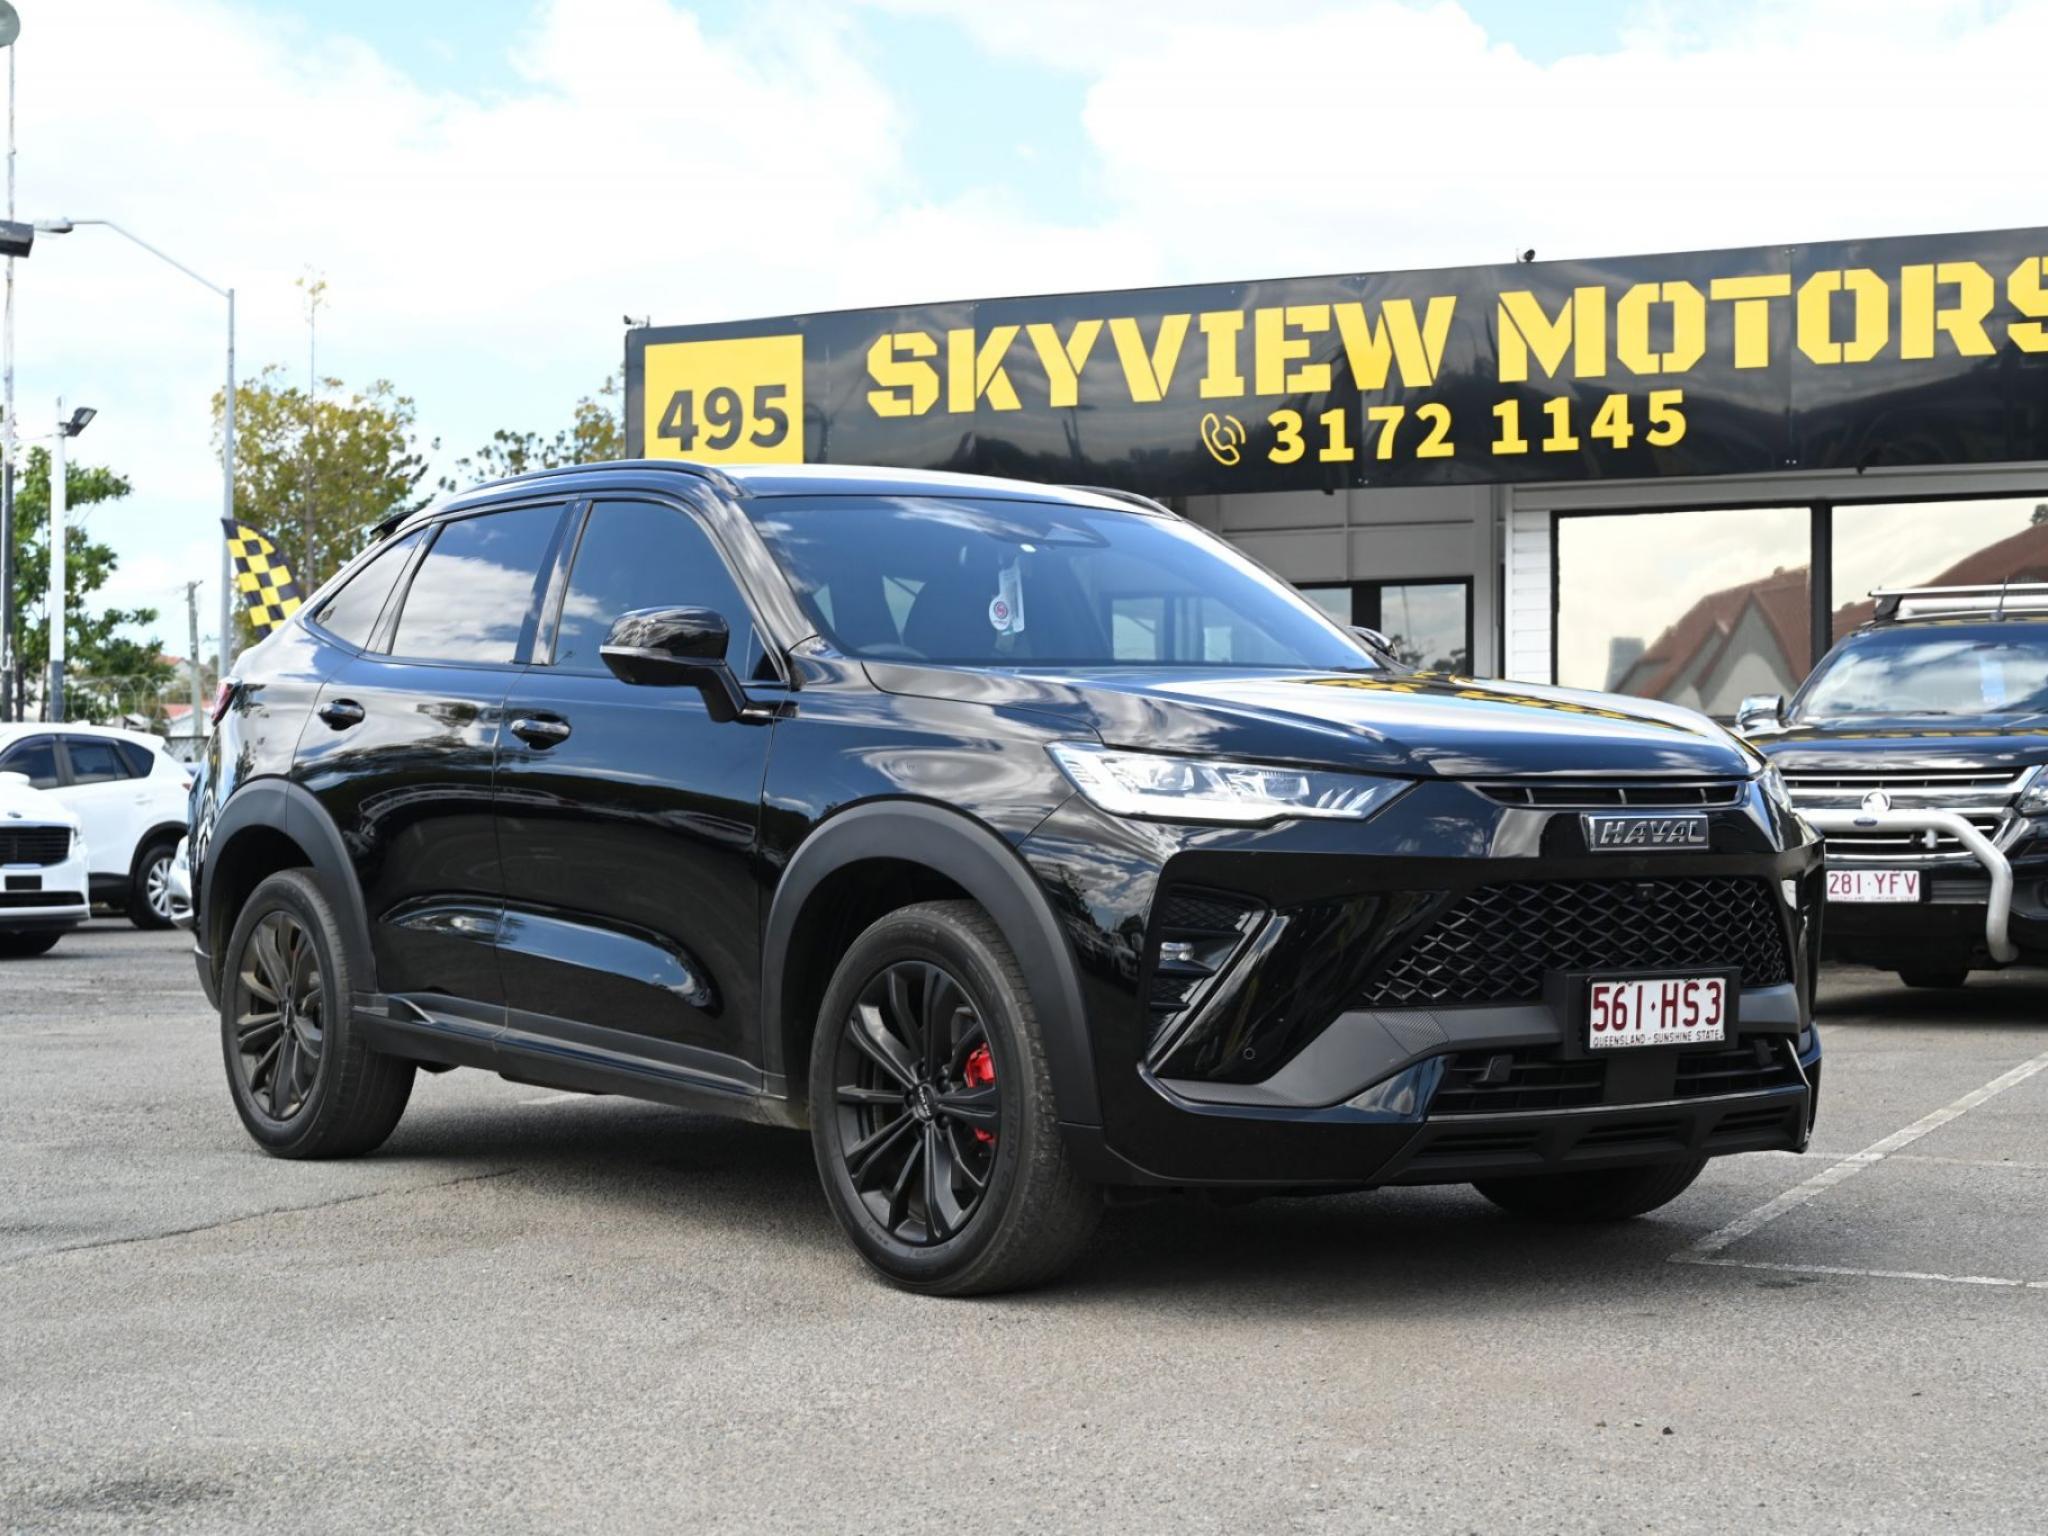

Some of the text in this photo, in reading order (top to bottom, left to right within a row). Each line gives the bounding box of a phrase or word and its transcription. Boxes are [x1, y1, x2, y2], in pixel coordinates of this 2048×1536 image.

[868, 297, 1456, 417] SKYVIEW
[657, 383, 789, 452] 495
[1268, 389, 1689, 465] 3172 1145
[1600, 820, 1706, 844] HAVAL
[1593, 1030, 1719, 1047] QUEENSLAND SUNSHINE STATE
